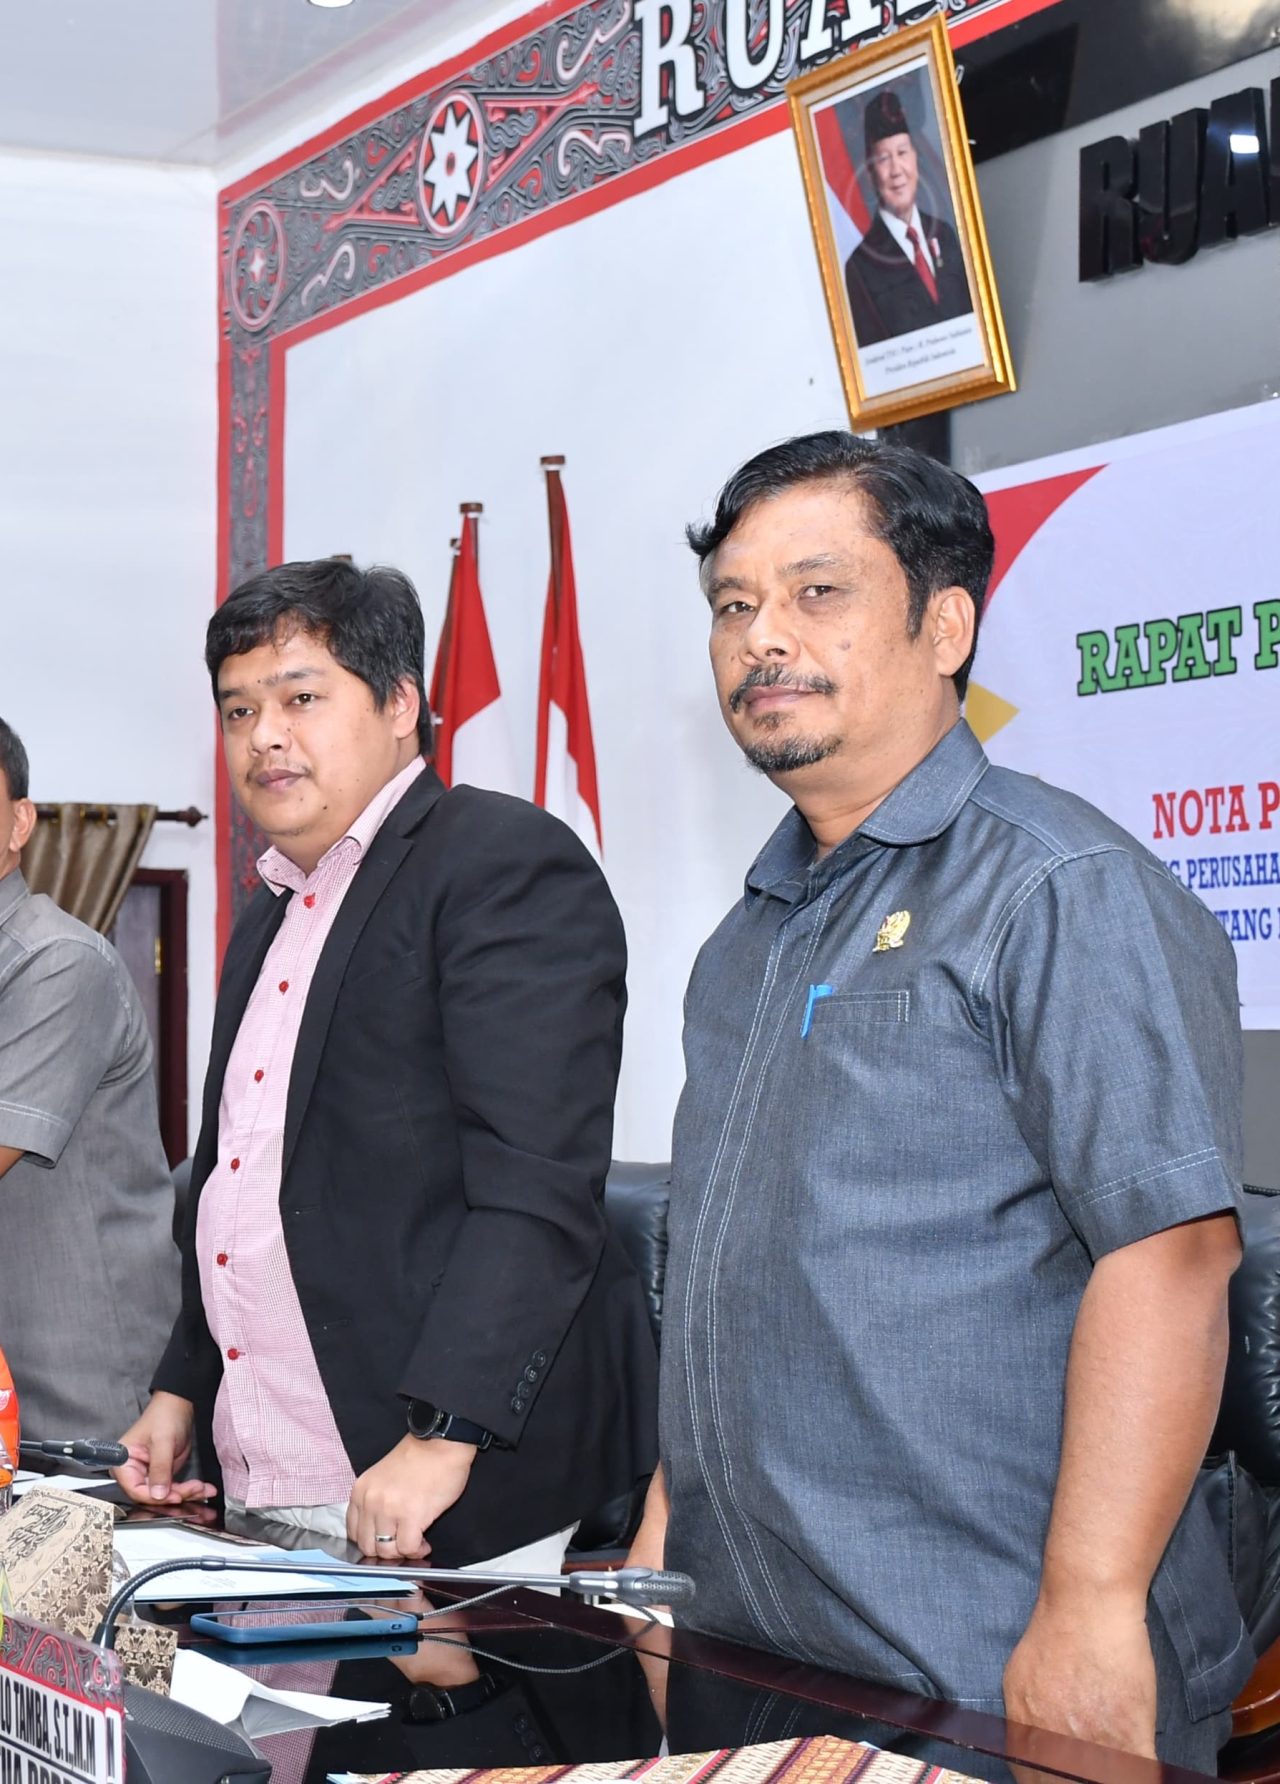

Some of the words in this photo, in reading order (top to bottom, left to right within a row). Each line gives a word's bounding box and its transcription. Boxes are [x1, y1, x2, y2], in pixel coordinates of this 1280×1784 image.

[1079, 76, 1280, 283] RUA
[1076, 605, 1242, 697] RAPAT
[1152, 784, 1250, 839] NOTA
[1186, 852, 1280, 889] PERUSAHA
